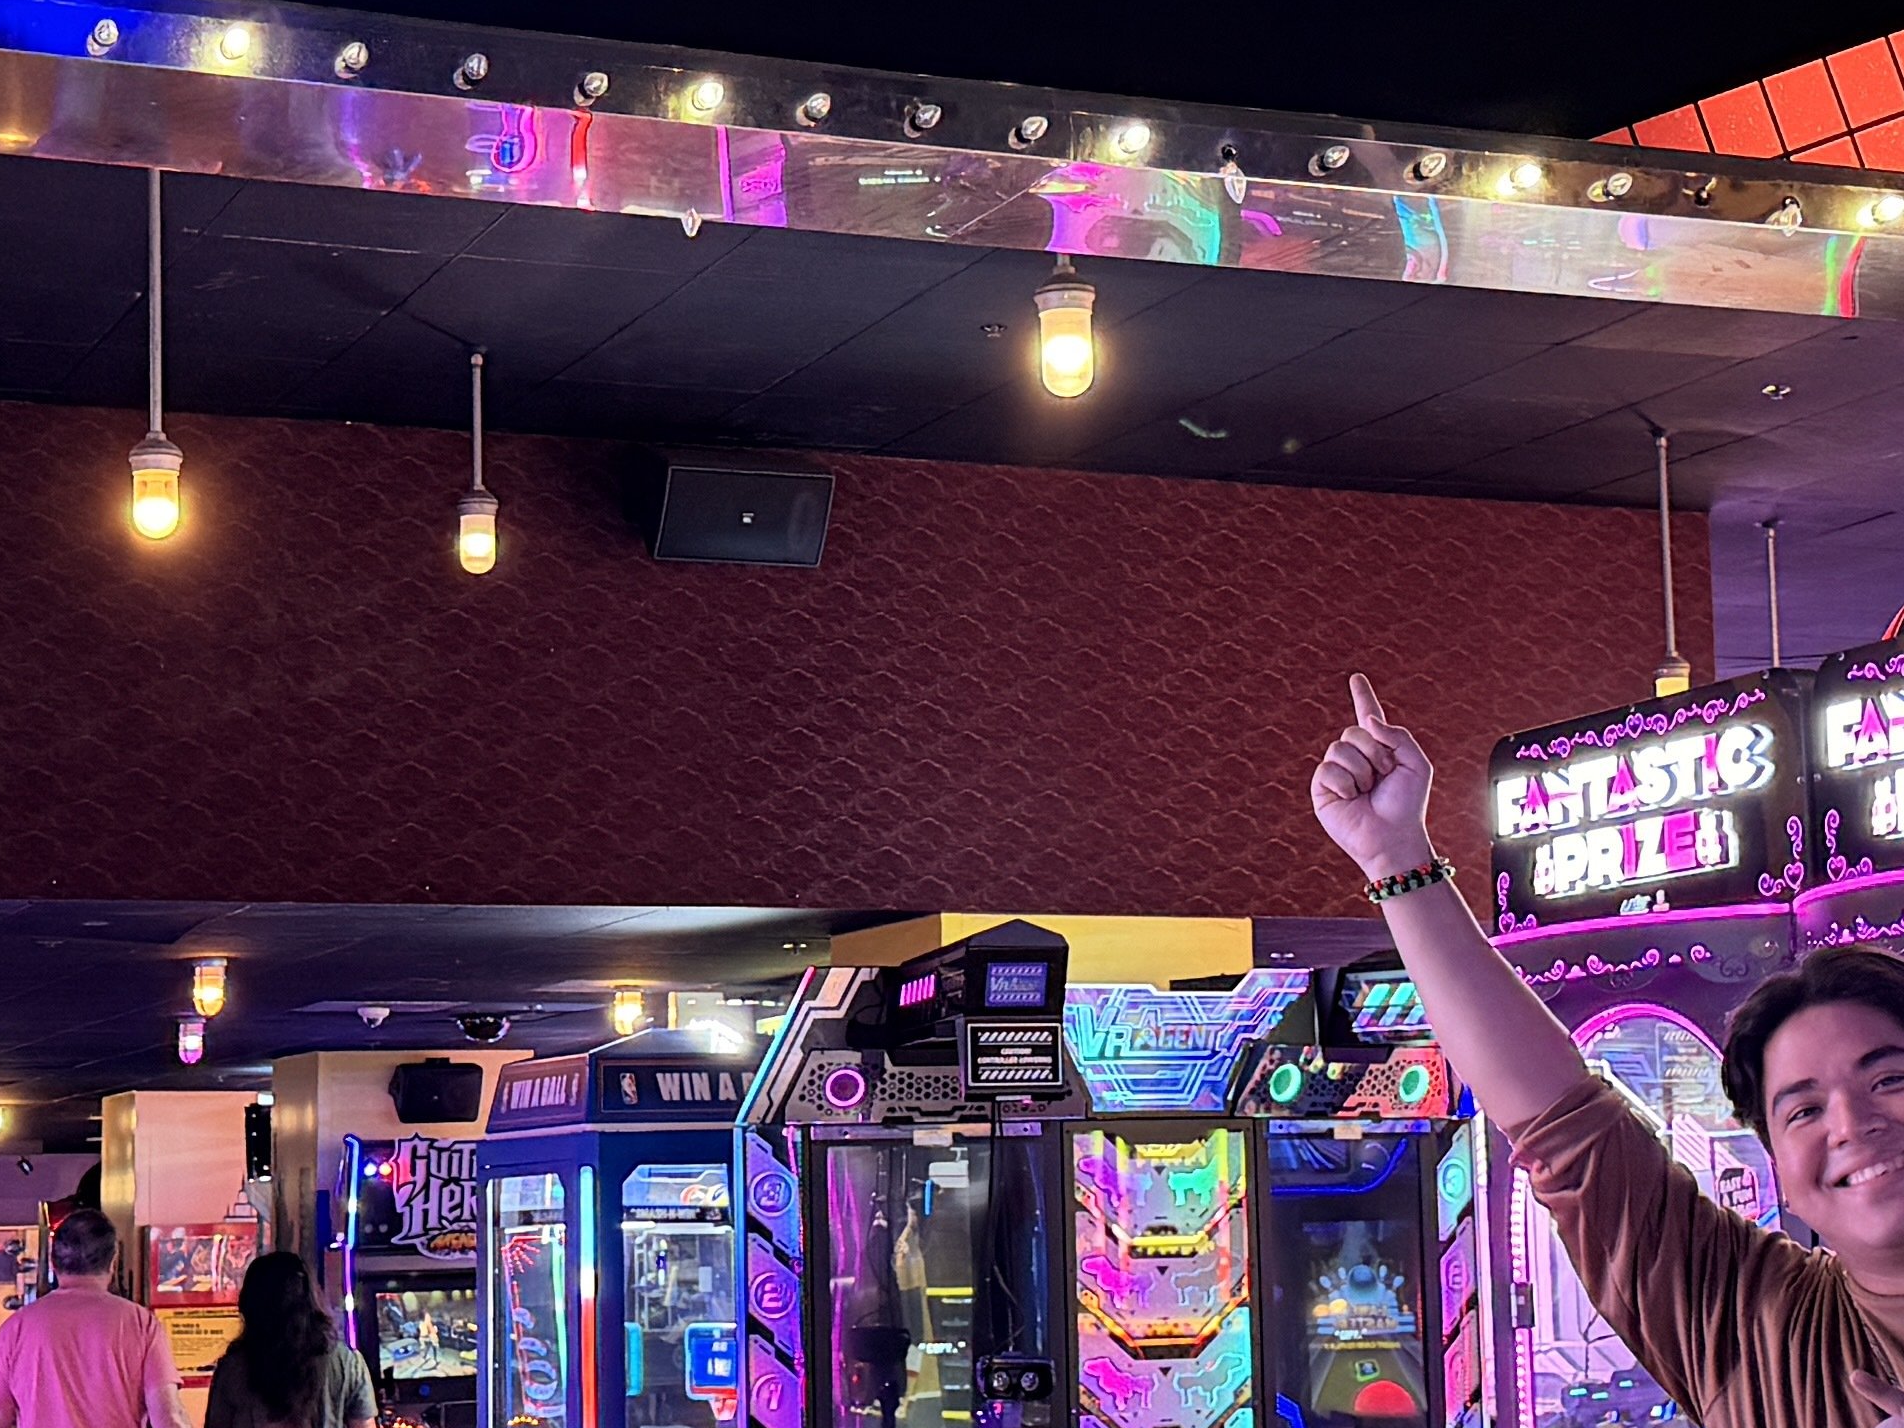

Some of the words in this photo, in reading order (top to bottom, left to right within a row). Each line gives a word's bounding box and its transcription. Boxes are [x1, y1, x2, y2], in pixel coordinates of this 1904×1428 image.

[1496, 724, 1776, 839] FANTASTIC
[1131, 1008, 1222, 1051] AGENT
[655, 1072, 712, 1102] WIN
[718, 1072, 738, 1101] A
[396, 1136, 477, 1209] GUIT
